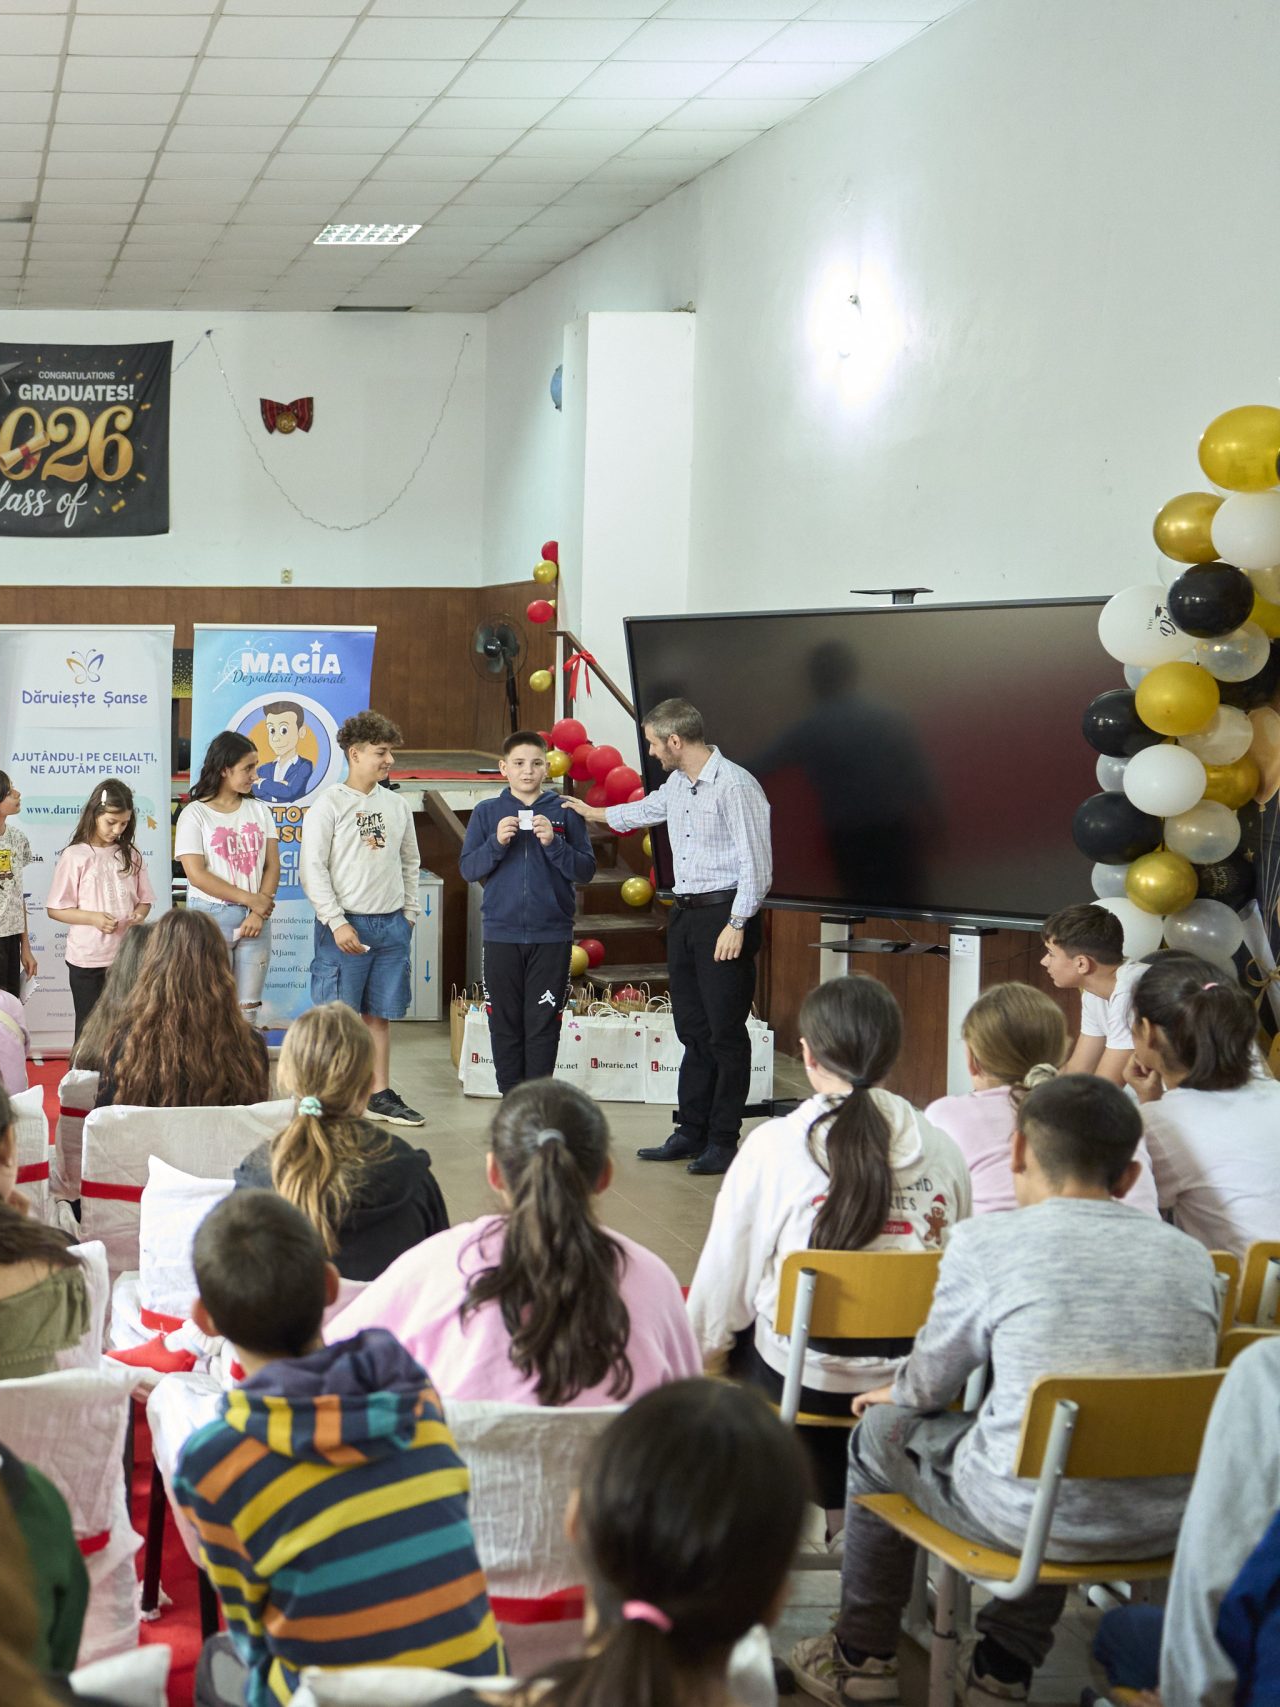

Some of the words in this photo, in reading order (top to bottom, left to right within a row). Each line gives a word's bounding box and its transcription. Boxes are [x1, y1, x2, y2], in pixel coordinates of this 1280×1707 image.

[38, 370, 116, 380] CONGRATULATIONS
[18, 383, 135, 402] GRADUATES!
[56, 482, 88, 528] of
[241, 650, 341, 675] MAGIA
[293, 671, 346, 686] personale
[22, 689, 96, 708] Dăruiește
[103, 690, 148, 708] Șanse
[12, 750, 83, 762] AJUTÂNDU-I
[86, 752, 100, 762] PE
[102, 752, 157, 765] CEILALȚI,
[30, 765, 45, 774] NE
[48, 763, 95, 774] AJUTĂM
[98, 765, 113, 774] PE
[115, 765, 140, 774] NOI!
[227, 831, 260, 855] CALI
[590, 1057, 638, 1070] Librarie.net
